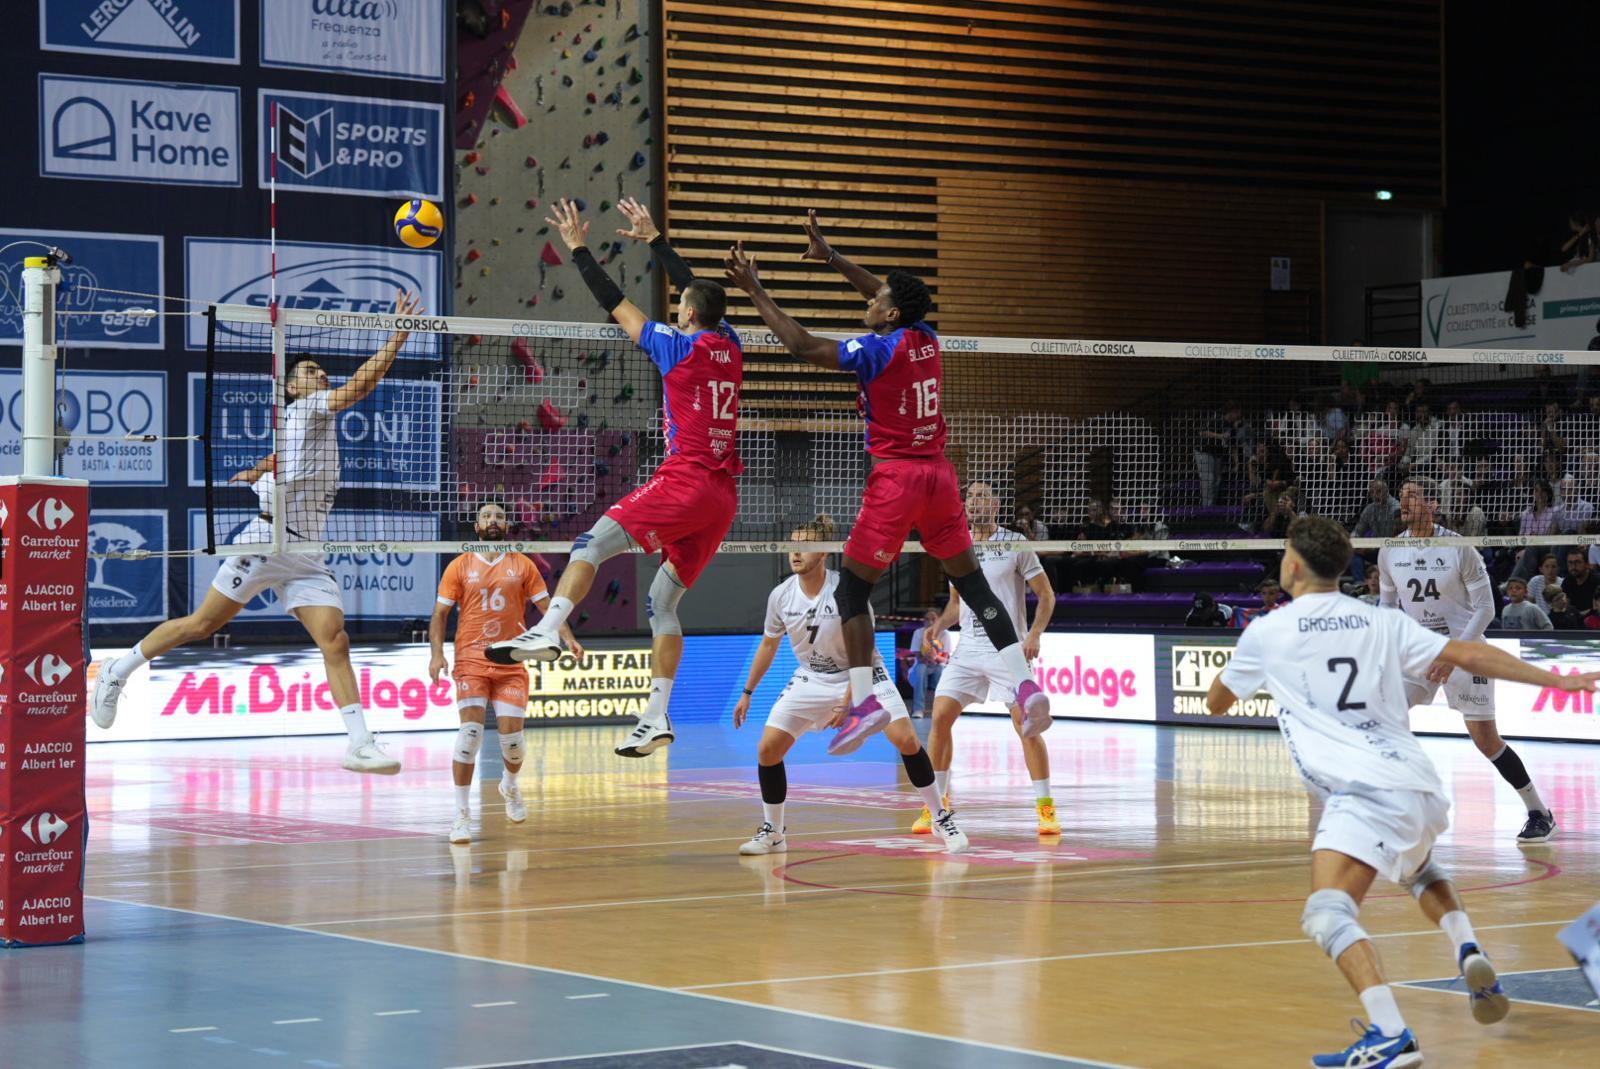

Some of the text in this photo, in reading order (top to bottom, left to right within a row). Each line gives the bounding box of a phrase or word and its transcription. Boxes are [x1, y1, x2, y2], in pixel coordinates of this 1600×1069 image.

[311, 18, 382, 37] Frequenza
[131, 99, 212, 134] Kave
[335, 121, 428, 147] SPORTS
[132, 133, 230, 167] Home
[335, 147, 403, 169] &PRO
[315, 313, 383, 329] CULLETTIVITÀ
[394, 318, 449, 332] CORSICA
[512, 323, 584, 338] COLLECTIVITÉ
[945, 339, 979, 351] CORSE
[1092, 343, 1136, 355] CORSICA
[1254, 346, 1286, 359] CORSE
[1388, 350, 1428, 362] CORSICA
[1535, 352, 1565, 364] CORSE
[707, 380, 735, 420] 12
[912, 377, 938, 419] 16
[77, 441, 94, 456] de
[98, 441, 153, 457] Boissons
[82, 459, 110, 471] BASTIA
[118, 459, 153, 472] AJACCIO
[344, 456, 408, 472] MOBILIER
[21, 534, 80, 547] Carrefour
[1097, 542, 1113, 550] vert
[1204, 541, 1219, 550] vert
[1407, 539, 1423, 548] vert
[1505, 538, 1519, 546] vert
[355, 543, 376, 553] vert
[494, 543, 512, 552] vert
[750, 543, 767, 552] vert
[29, 549, 71, 560] market
[25, 584, 74, 596] AJACCIO
[232, 577, 242, 590] 9
[1406, 578, 1441, 603] 24
[22, 600, 57, 611] Albert
[60, 600, 77, 611] 1er
[479, 587, 506, 612] 16
[1298, 614, 1371, 633] GROSNON
[806, 625, 820, 645] 7
[1327, 656, 1367, 712] 2
[19, 691, 77, 703] Carrefour
[27, 704, 68, 715] market
[24, 742, 73, 754] AJACCIO
[21, 758, 76, 770] Albert 1er
[15, 849, 74, 862] Carrefour
[23, 862, 65, 874] market
[22, 897, 71, 911] AJACCIO
[19, 914, 74, 926] Albert 1er
